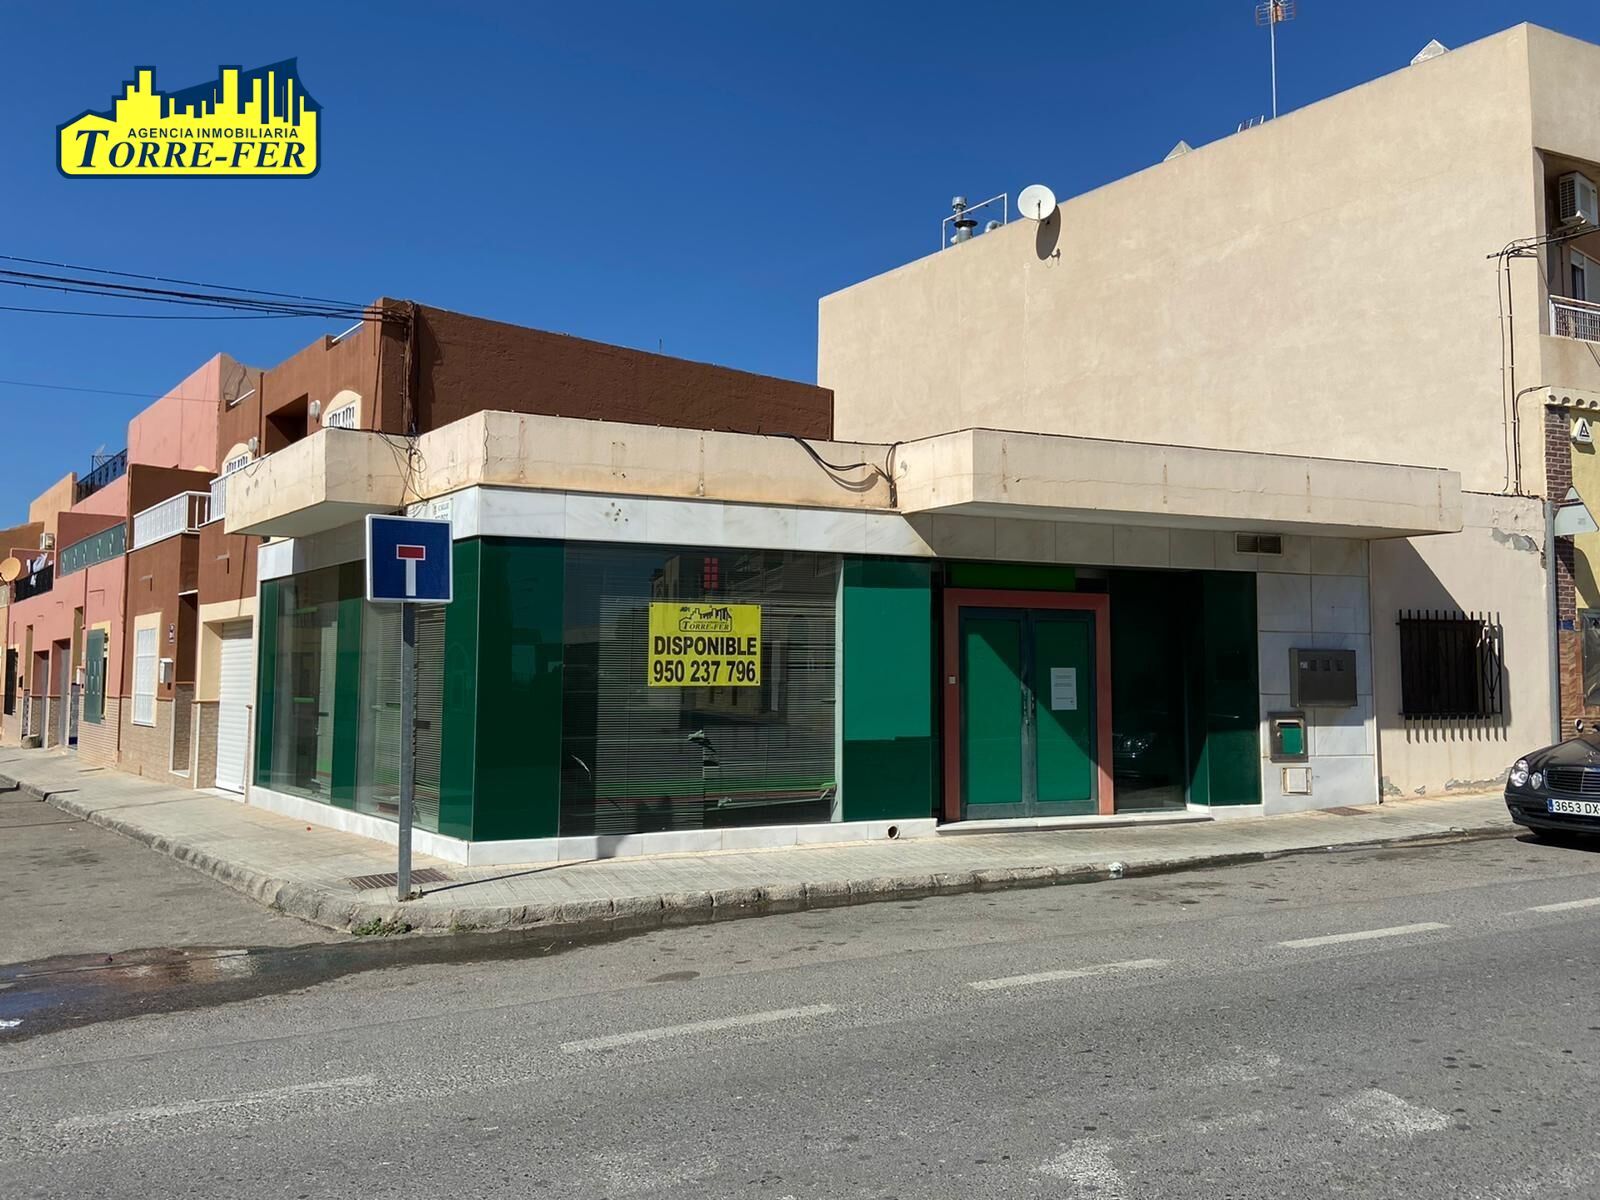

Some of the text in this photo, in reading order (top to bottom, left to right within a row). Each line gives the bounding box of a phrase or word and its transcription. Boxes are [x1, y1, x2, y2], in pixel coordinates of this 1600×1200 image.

[654, 636, 757, 656] DISPONIBLE
[653, 659, 756, 682] 950 237 796
[1555, 800, 1600, 815] 3653 DX
